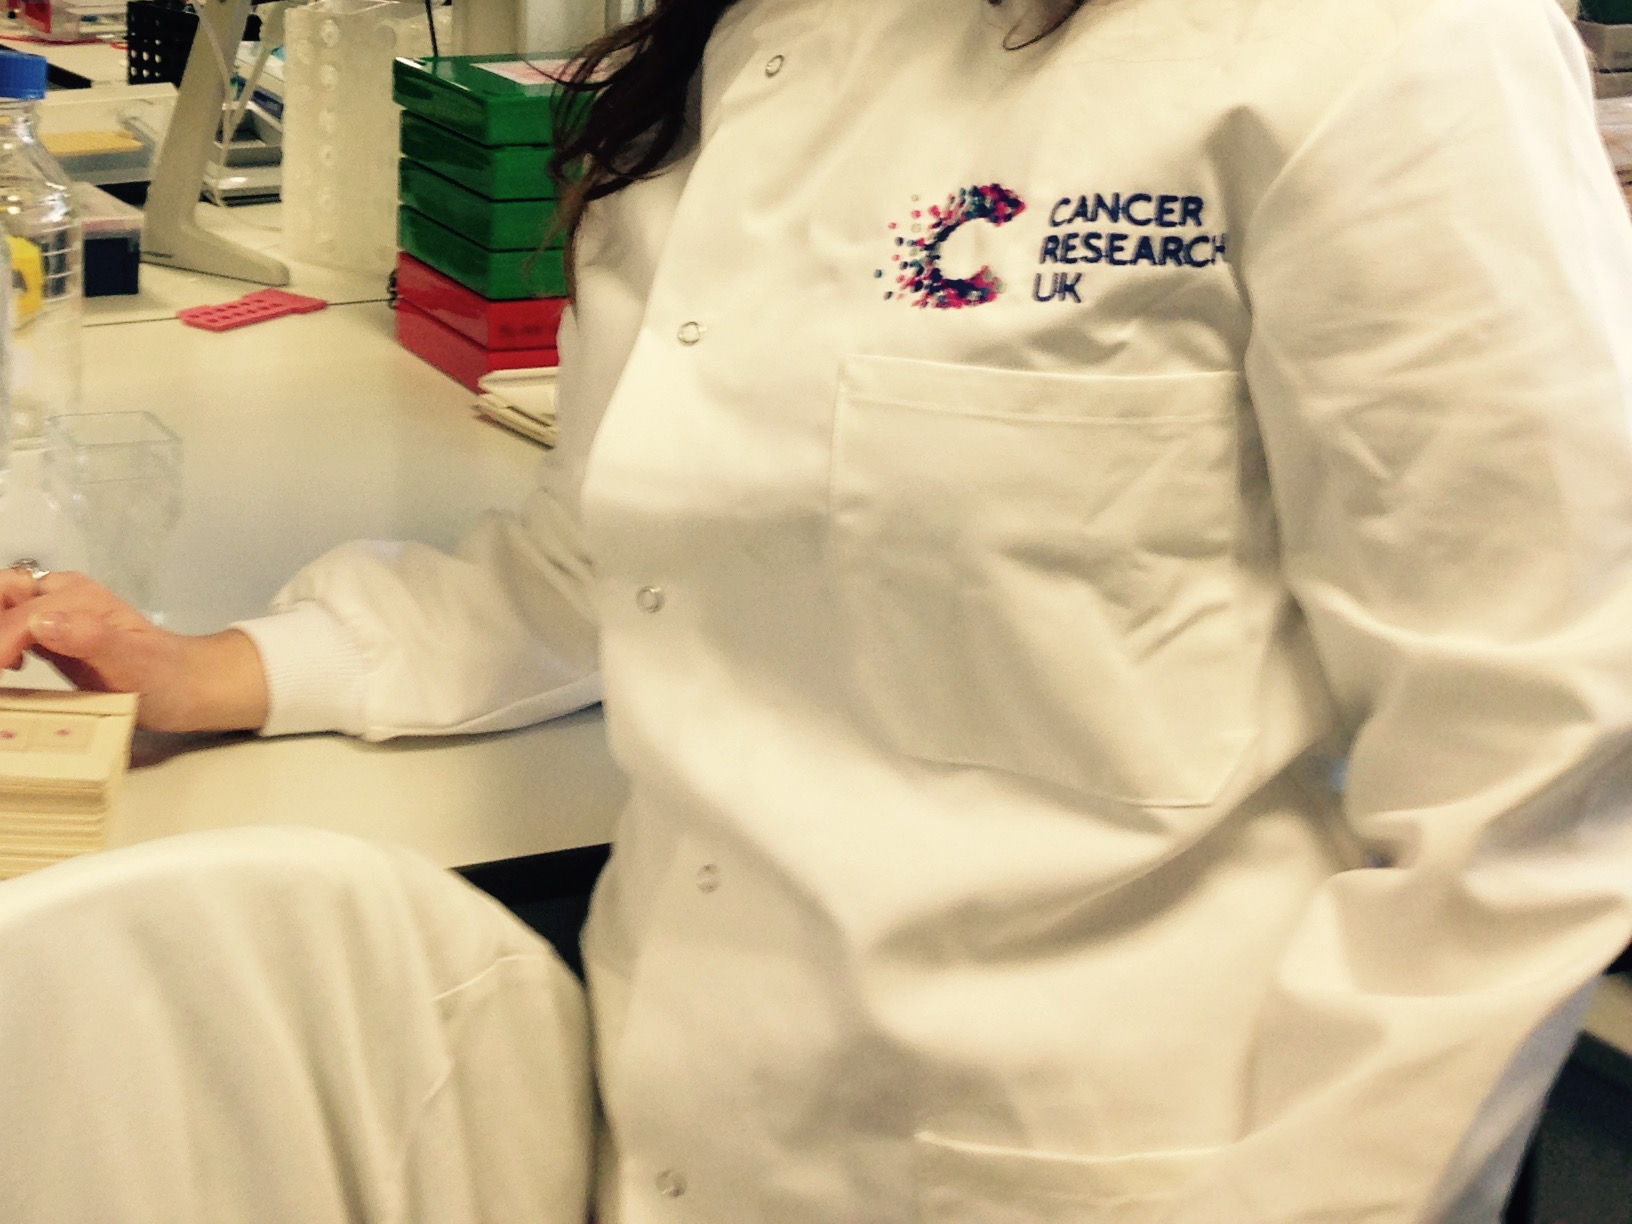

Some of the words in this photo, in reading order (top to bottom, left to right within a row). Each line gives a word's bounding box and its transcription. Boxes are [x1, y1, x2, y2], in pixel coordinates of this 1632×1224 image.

[1048, 192, 1205, 229] CANCER
[1040, 232, 1227, 268] RESEARCH
[1032, 272, 1084, 304] UK
